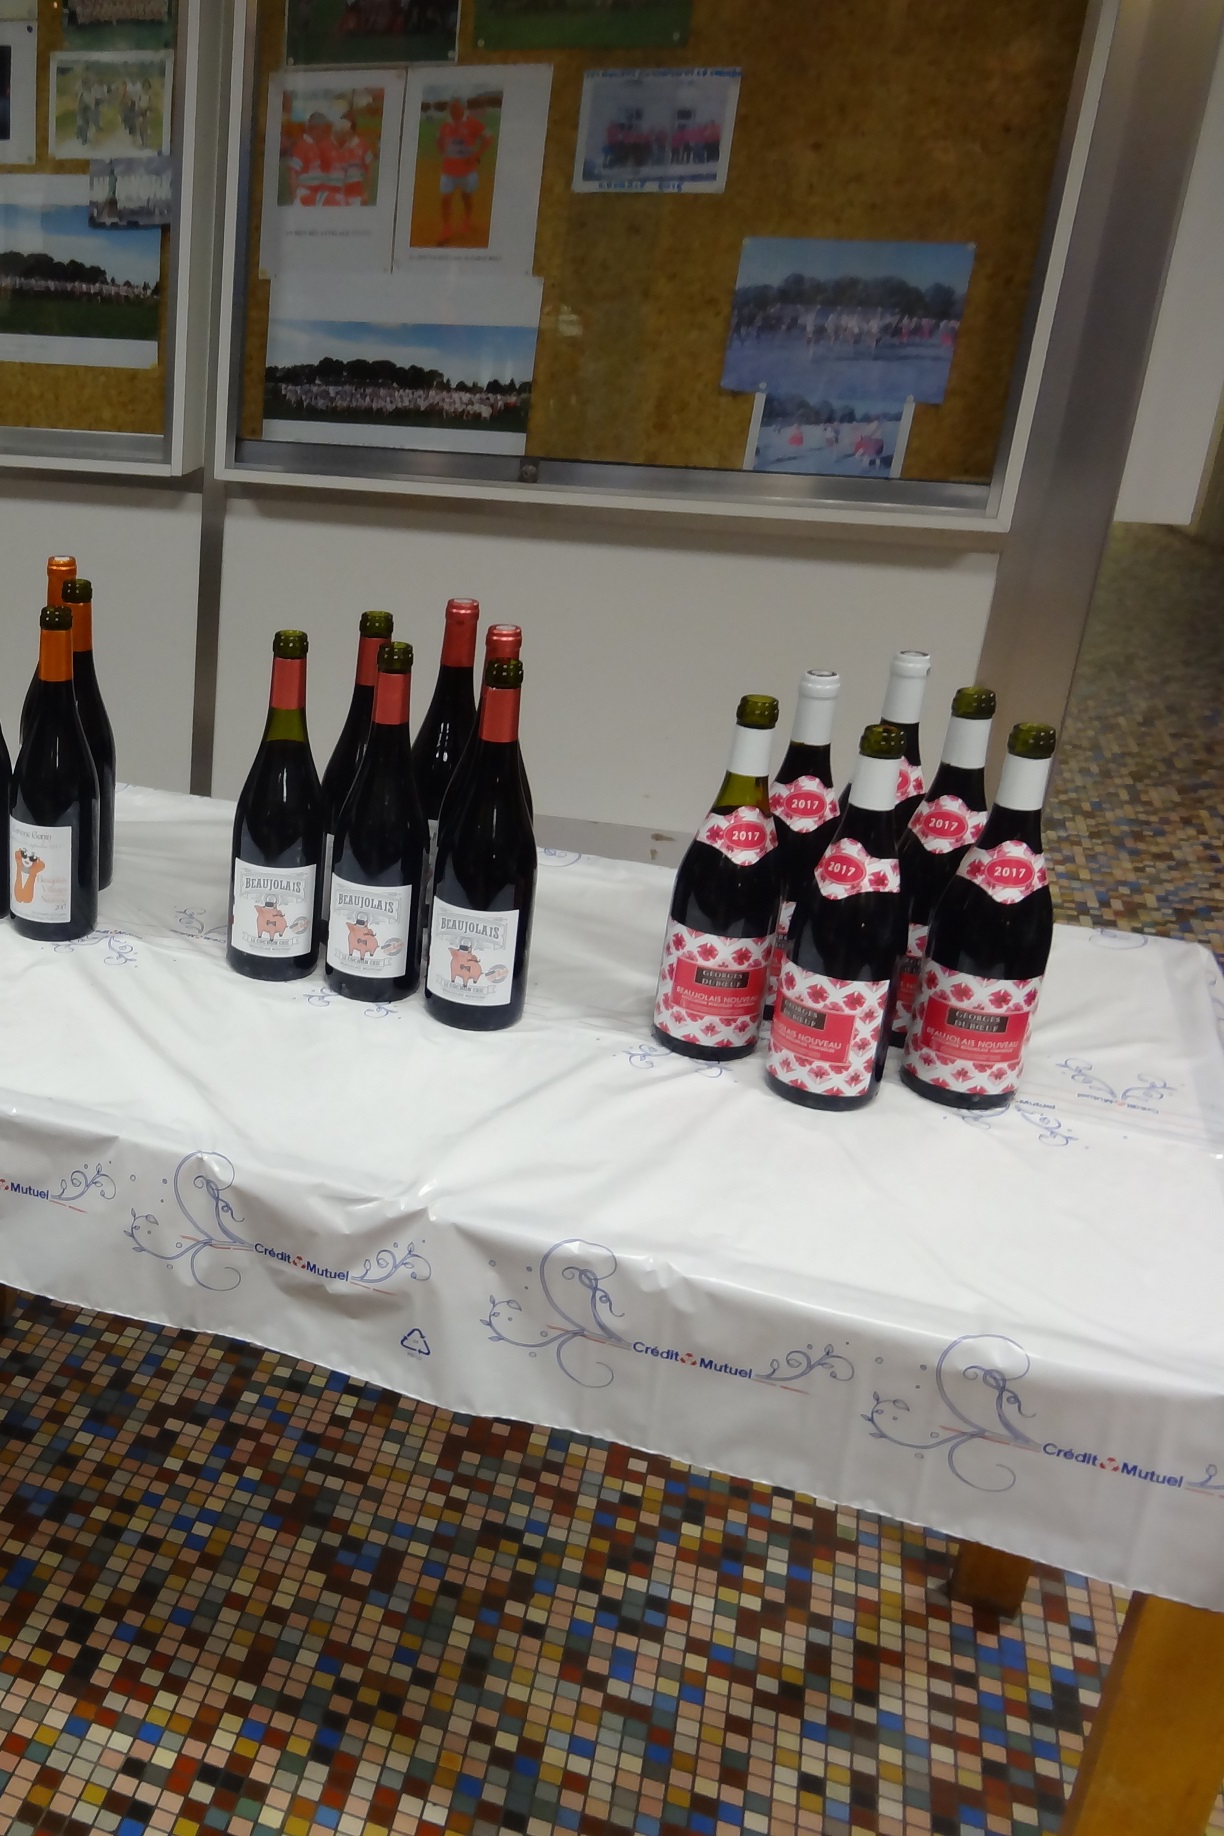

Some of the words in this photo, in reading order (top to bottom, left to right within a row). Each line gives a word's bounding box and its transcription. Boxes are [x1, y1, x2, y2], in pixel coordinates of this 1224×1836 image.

[791, 799, 819, 810] 2017
[928, 817, 959, 831] 2017
[732, 830, 761, 841] 2017
[828, 861, 856, 877] 2017
[993, 866, 1027, 879] 2017
[245, 877, 302, 893] BEAUJOLAIS
[338, 893, 394, 914] BEAUJOLAIS
[441, 917, 500, 939] BEAUJOLAIS
[702, 969, 743, 979] GEORGES
[676, 985, 722, 1003] BEAUJOLAIS
[784, 999, 818, 1019] GEORGES
[955, 1010, 1001, 1023] GEORGES
[797, 1033, 842, 1050] NOUVEAU
[926, 1026, 975, 1047] BEAUJOLAIS
[976, 1039, 1019, 1049] NOUVEAU
[10, 1182, 49, 1200] Mutuel
[254, 1242, 292, 1264] Crédit
[306, 1260, 349, 1282] Mutuel
[632, 1341, 680, 1362] Crédit
[699, 1357, 753, 1379] Mutuel
[1042, 1442, 1099, 1467] Crédit
[1120, 1462, 1185, 1488] Mutuel
